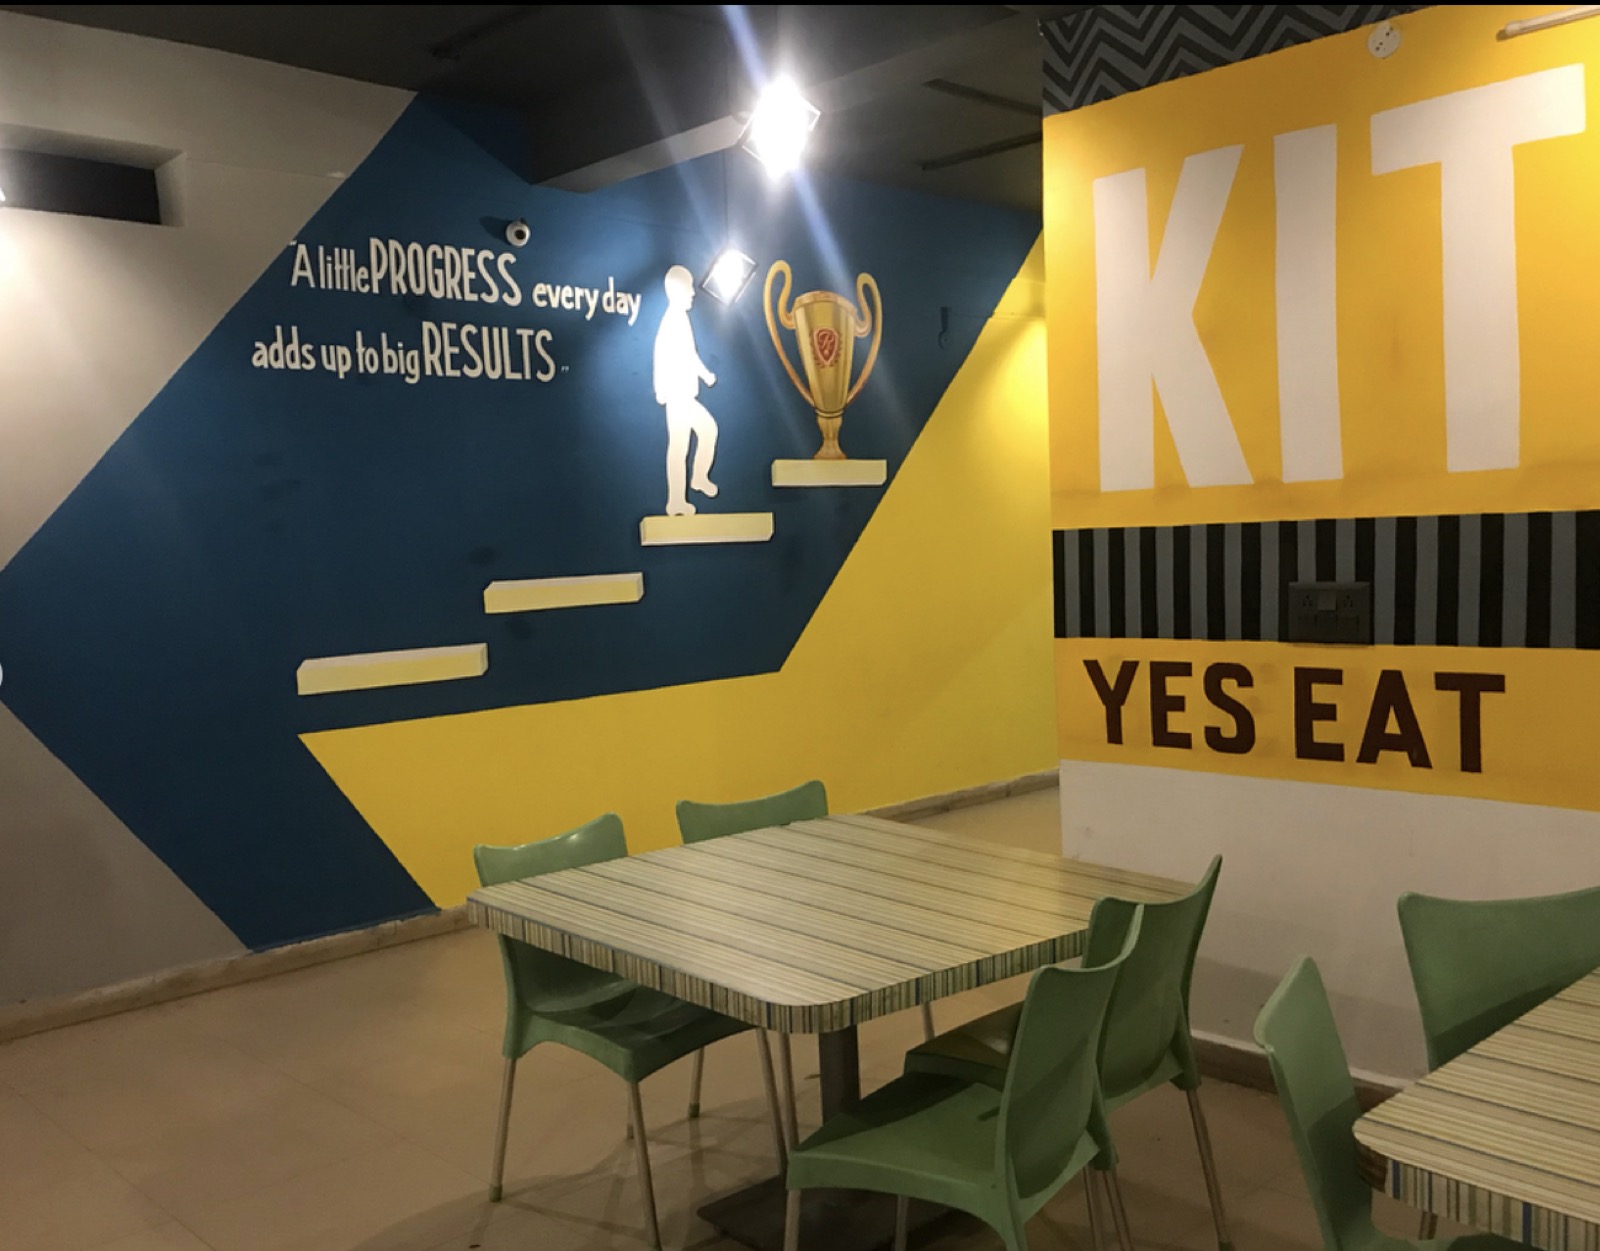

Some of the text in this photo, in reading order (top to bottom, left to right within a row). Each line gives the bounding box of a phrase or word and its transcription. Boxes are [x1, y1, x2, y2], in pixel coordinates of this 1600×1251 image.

[319, 246, 370, 294] little
[370, 238, 522, 307] PROGRESS
[532, 282, 600, 320] every
[602, 277, 642, 326] day
[1093, 63, 1586, 492] KIT
[251, 325, 317, 370] adds
[321, 345, 353, 379] up
[356, 330, 379, 373] to
[381, 332, 420, 383] big
[1083, 659, 1506, 774] YES EAT
